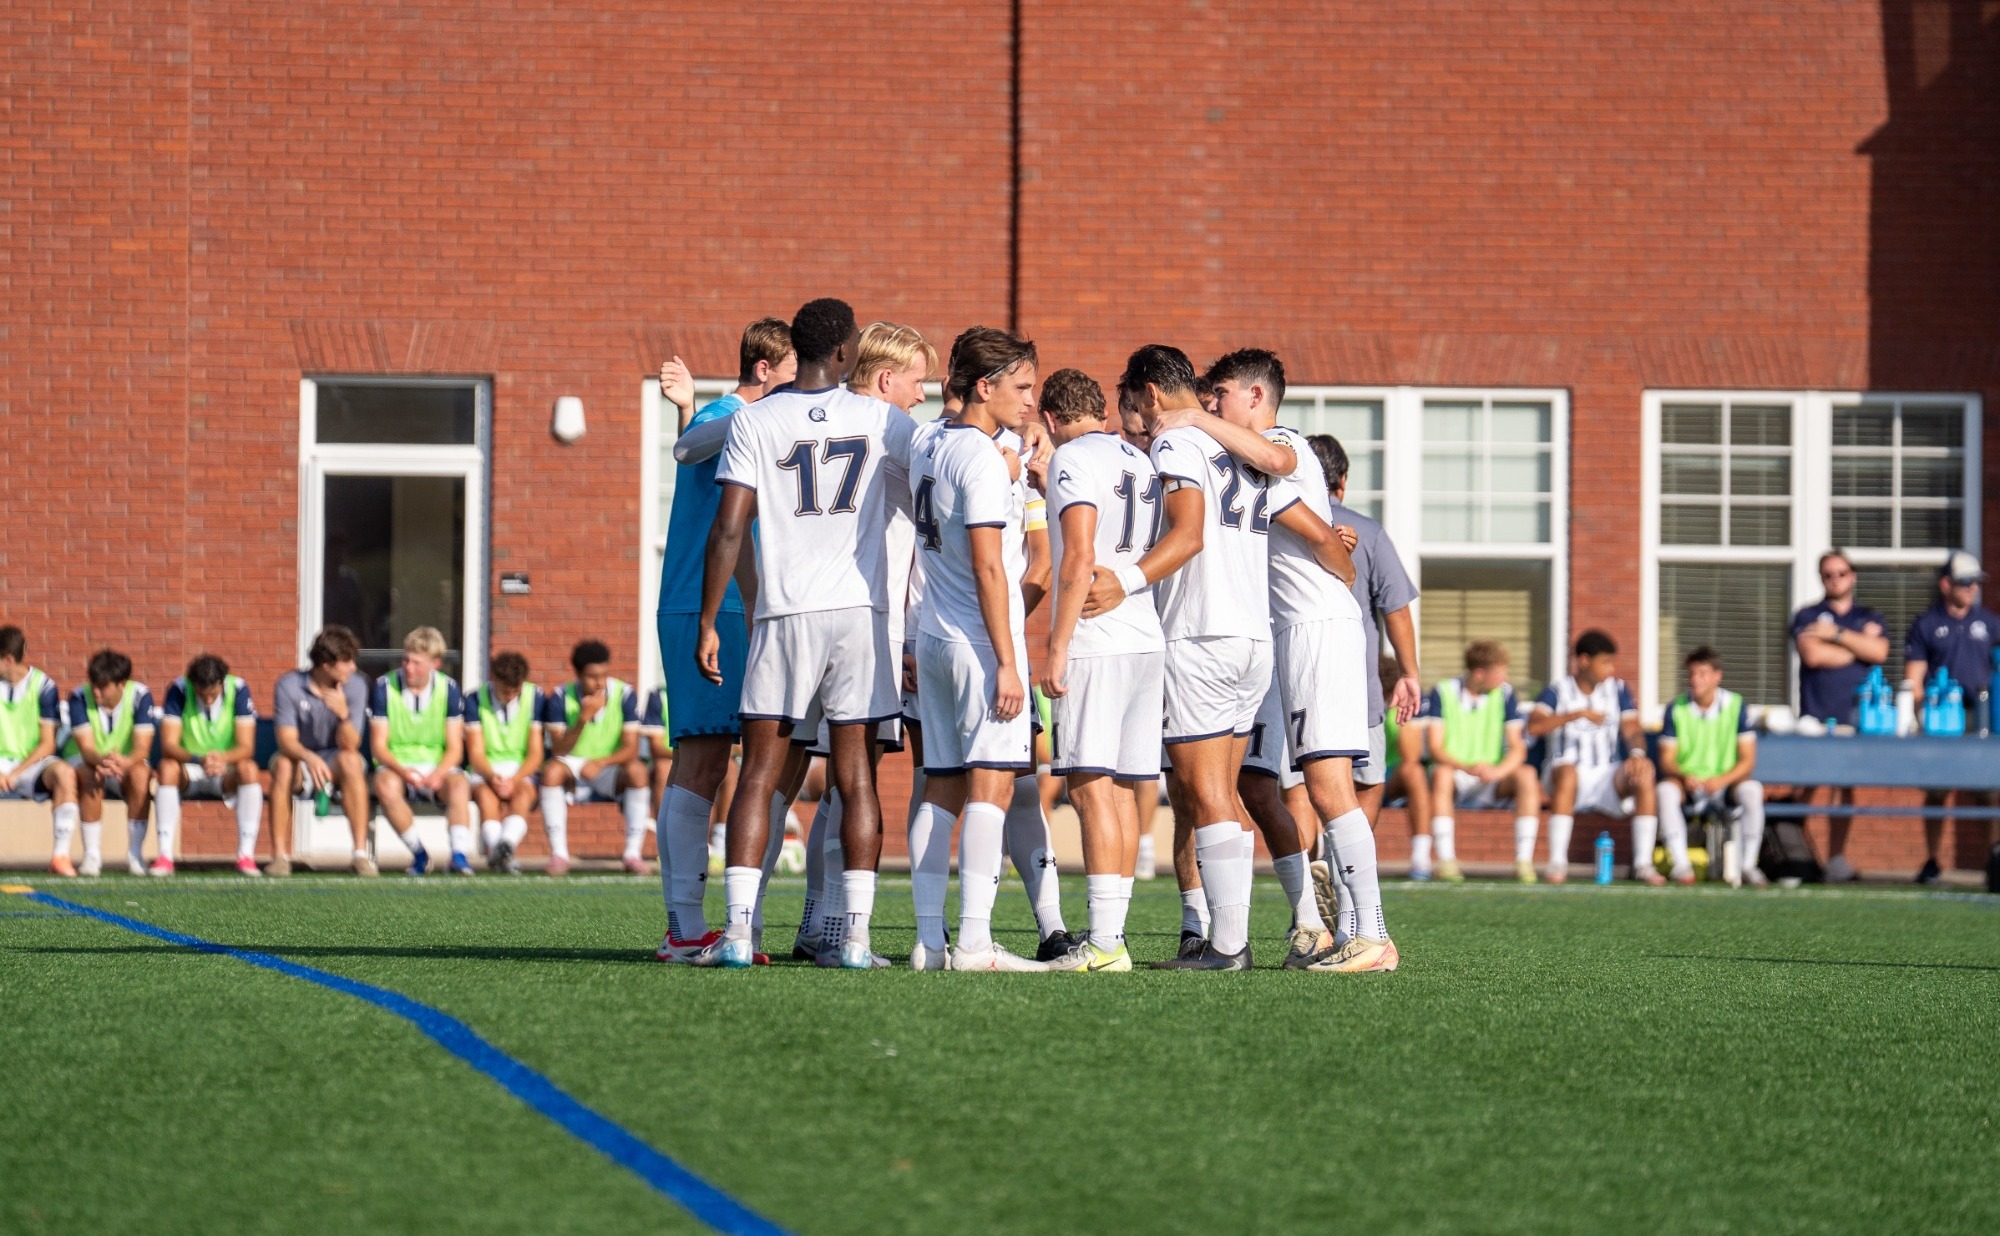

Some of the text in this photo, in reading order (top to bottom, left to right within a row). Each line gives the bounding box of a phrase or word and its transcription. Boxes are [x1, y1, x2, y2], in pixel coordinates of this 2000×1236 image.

[776, 435, 870, 517] 17
[915, 475, 942, 553] 4
[1114, 470, 1163, 553] 11
[1209, 451, 1268, 535] 22
[1291, 708, 1307, 748] 7
